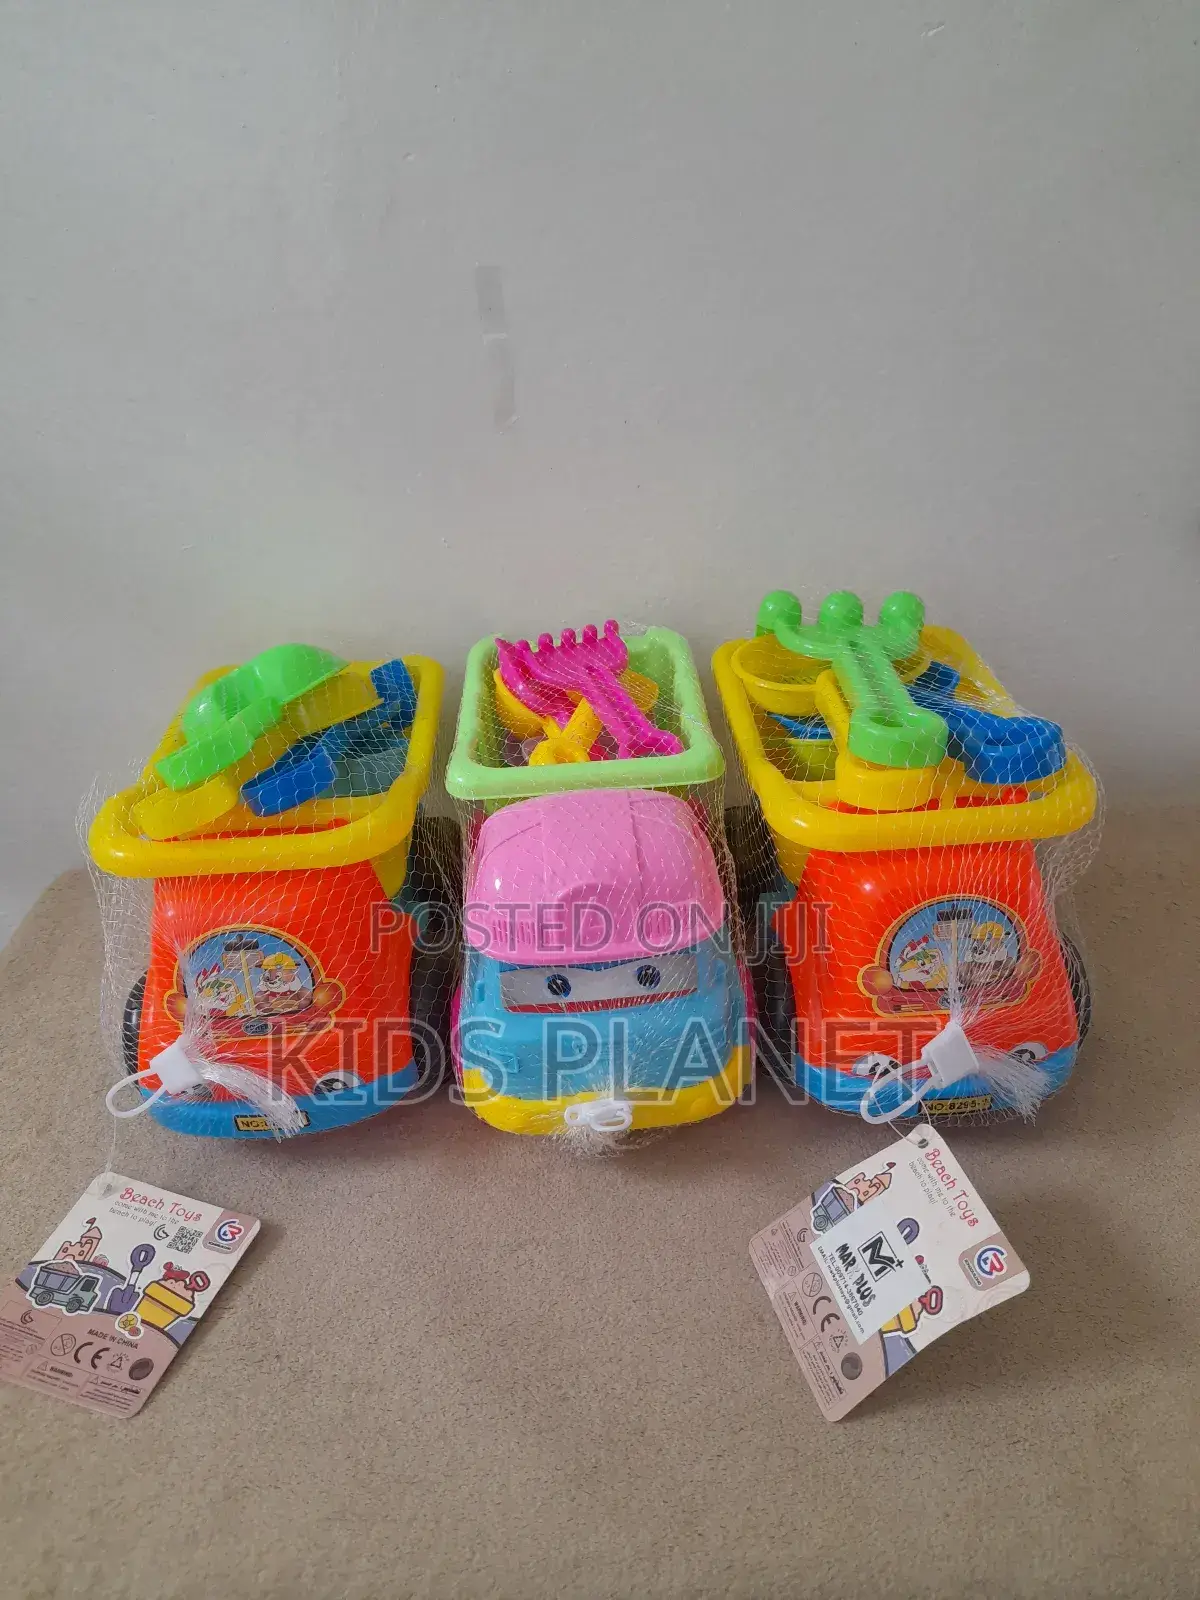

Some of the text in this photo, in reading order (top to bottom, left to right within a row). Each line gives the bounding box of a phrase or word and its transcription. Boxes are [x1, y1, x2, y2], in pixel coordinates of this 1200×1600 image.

[908, 1161, 922, 1180] beach
[925, 1148, 957, 1190] Beach
[953, 1190, 979, 1227] Toys
[927, 1173, 938, 1188] with
[935, 1187, 944, 1197] me
[120, 1187, 203, 1222] Beach Toys
[942, 1196, 949, 1206] to
[133, 1205, 148, 1215] with
[945, 1205, 956, 1217] the
[852, 1273, 876, 1307] PLUS
[87, 1328, 140, 1350] MADE IN CHINA
